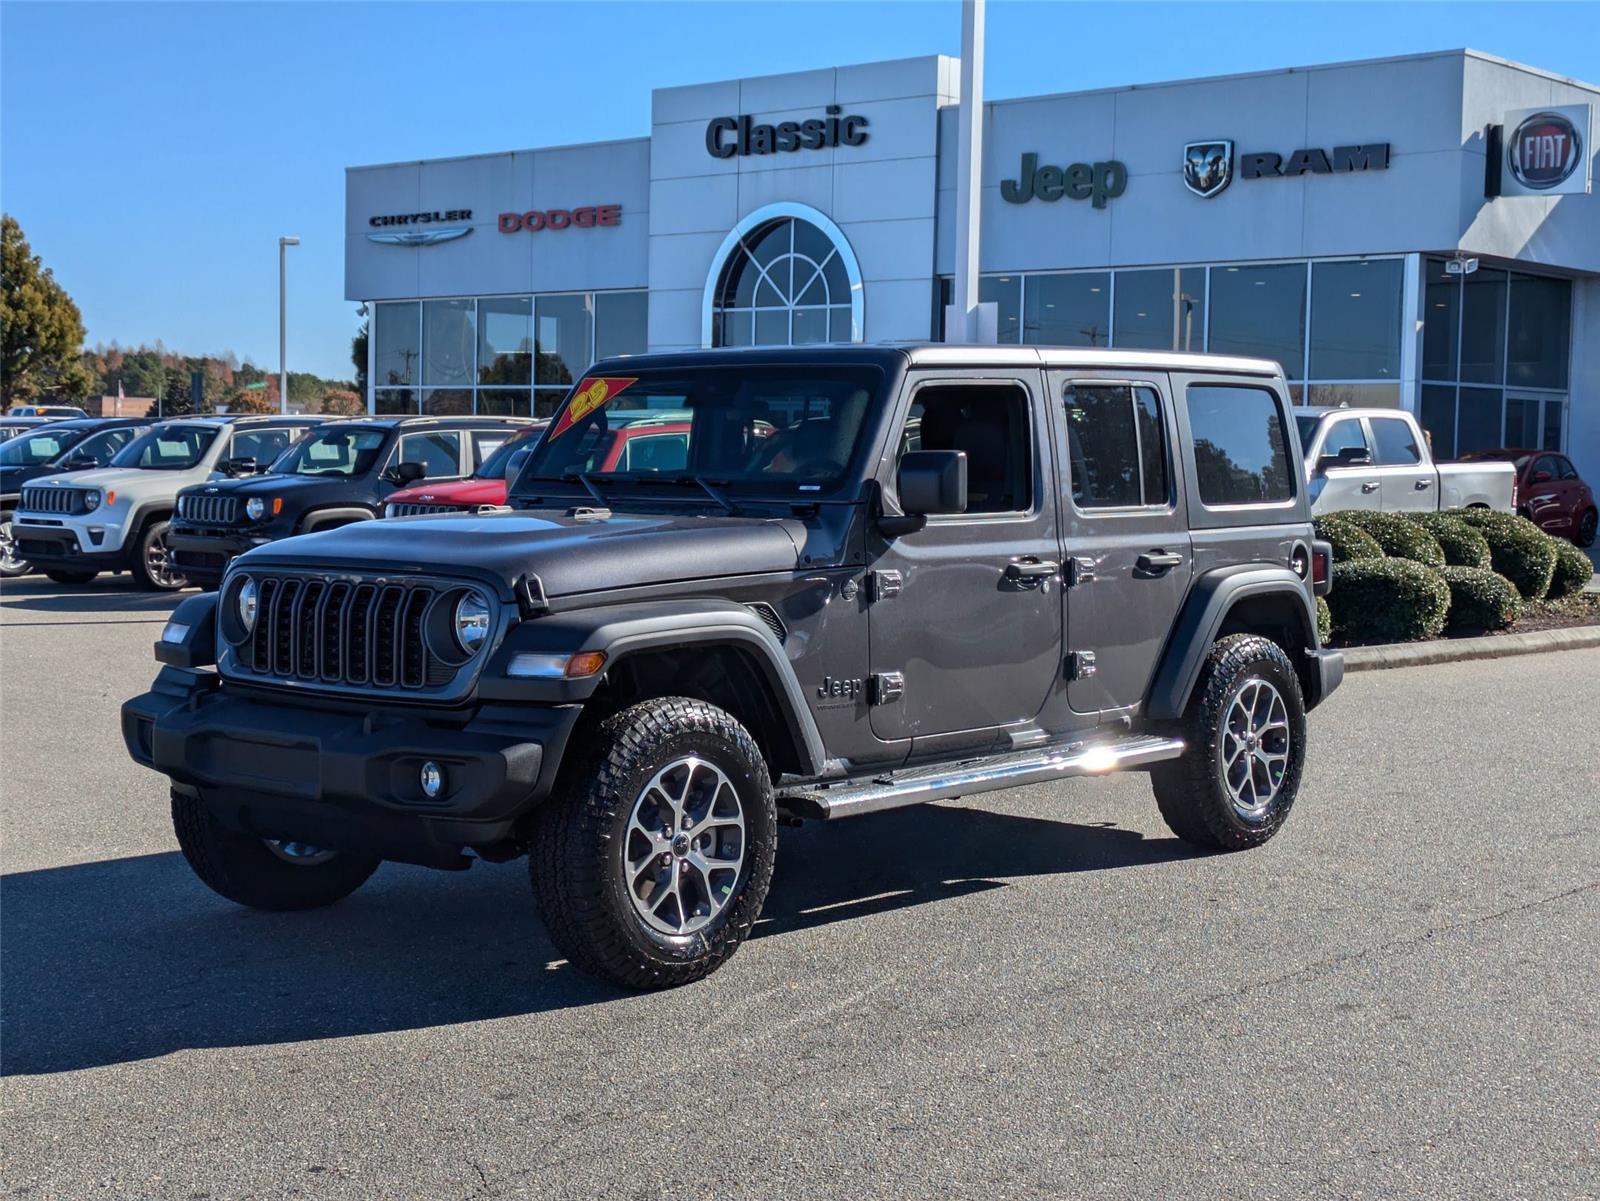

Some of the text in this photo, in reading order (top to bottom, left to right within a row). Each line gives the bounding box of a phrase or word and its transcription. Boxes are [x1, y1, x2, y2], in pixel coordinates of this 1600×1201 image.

[705, 105, 868, 159] Classic
[1241, 143, 1390, 179] RAM
[1523, 134, 1567, 170] FIAT
[1000, 152, 1127, 209] Jeep
[369, 209, 473, 227] CHRYSLER
[499, 204, 622, 233] DODGE
[817, 676, 862, 699] Jeep
